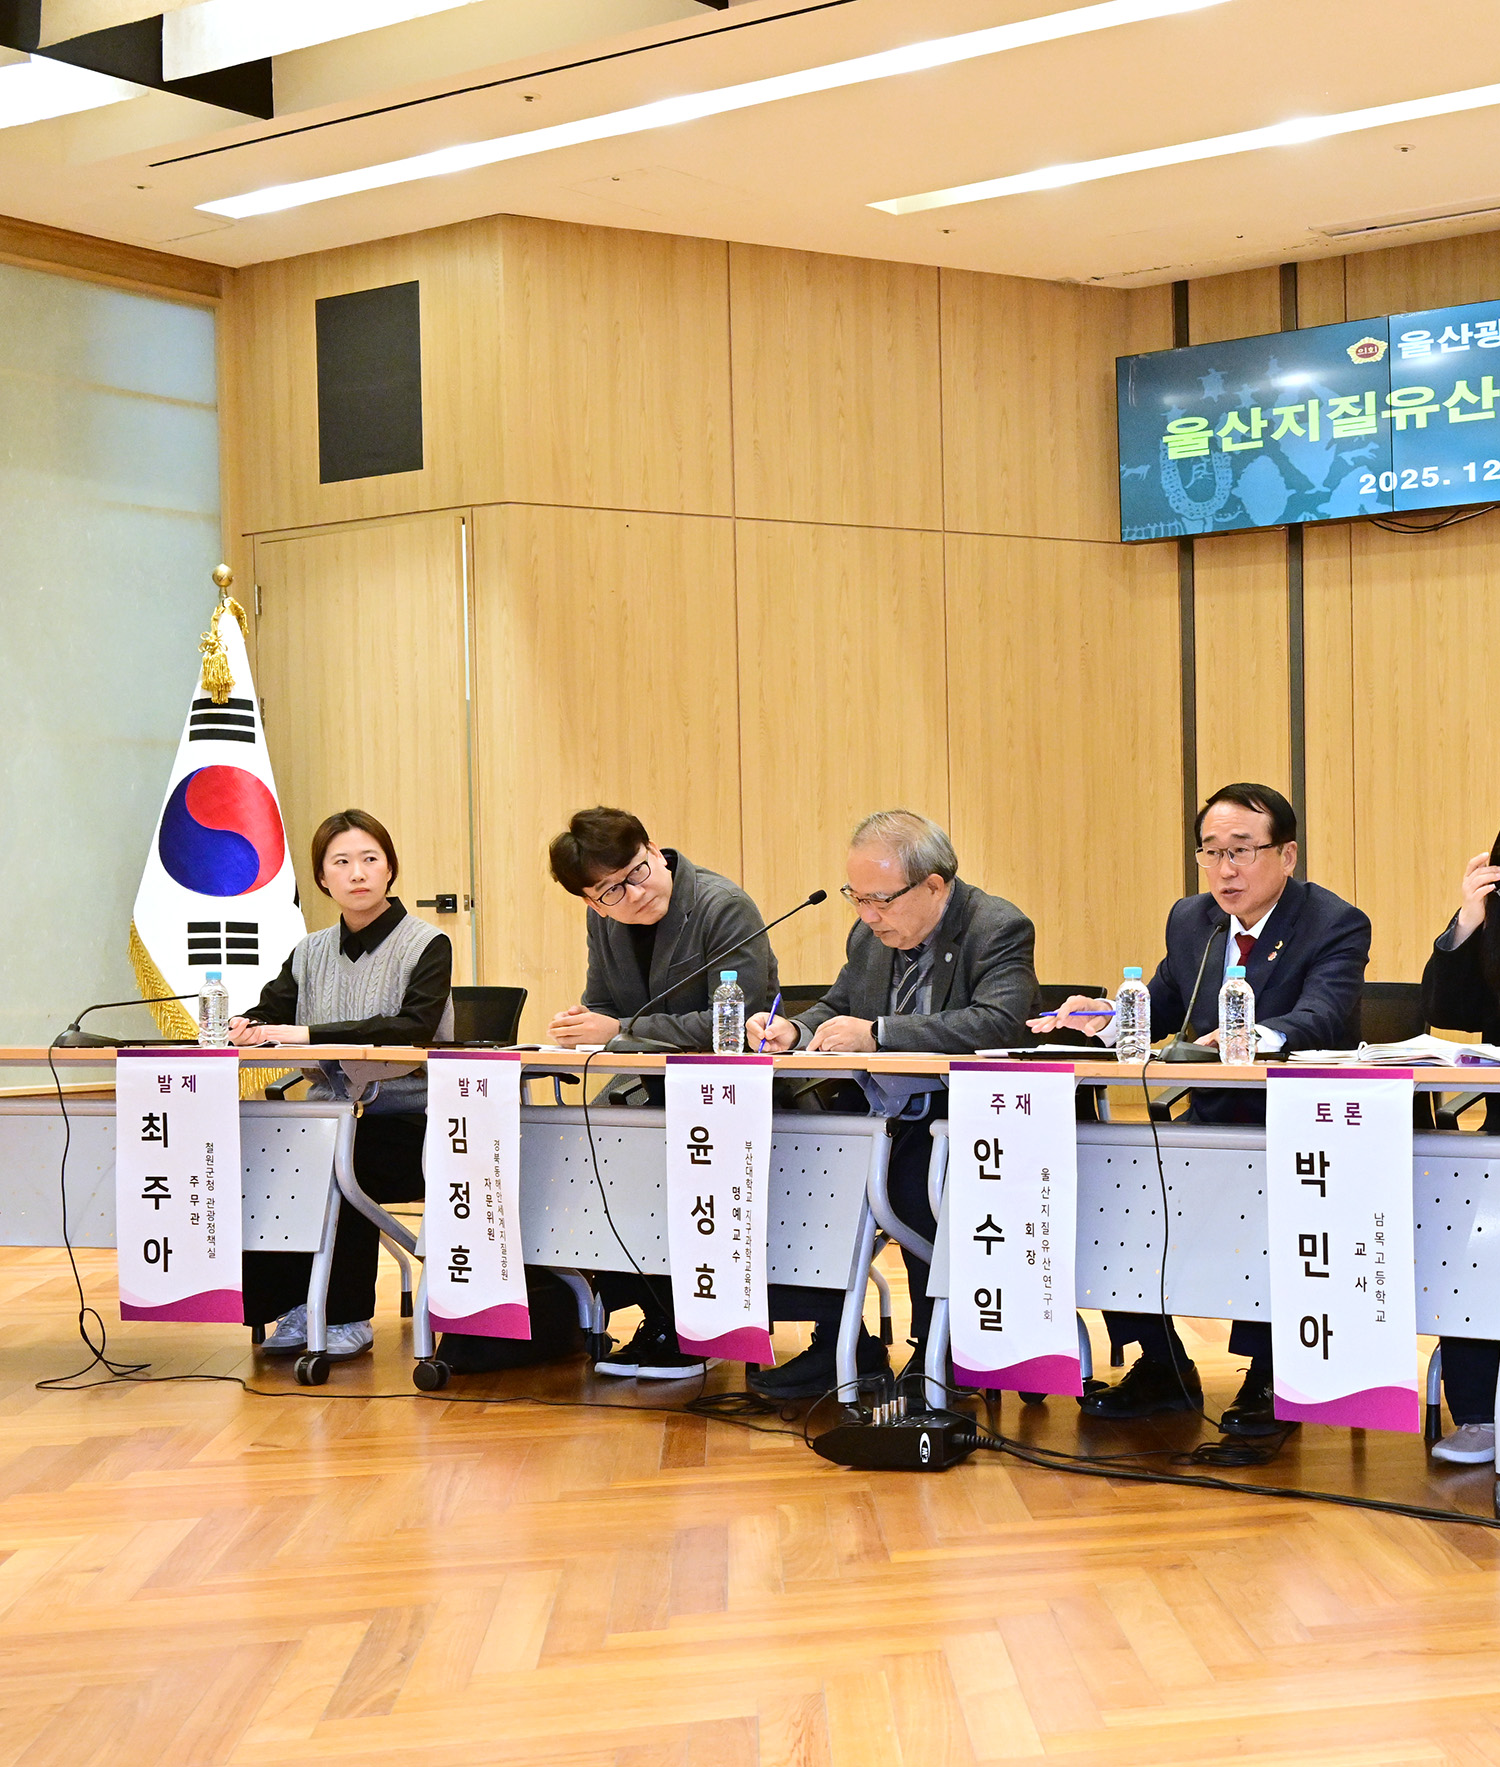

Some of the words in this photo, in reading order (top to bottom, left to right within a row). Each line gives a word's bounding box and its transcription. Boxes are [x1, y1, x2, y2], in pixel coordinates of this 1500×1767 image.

[1358, 466, 1452, 495] 2025.
[744, 1140, 754, 1203] 부산대학교
[205, 1197, 216, 1259] 관광정책실
[1040, 1167, 1053, 1323] 울산지질유산연구회
[1373, 1212, 1387, 1323] 남목고등학교
